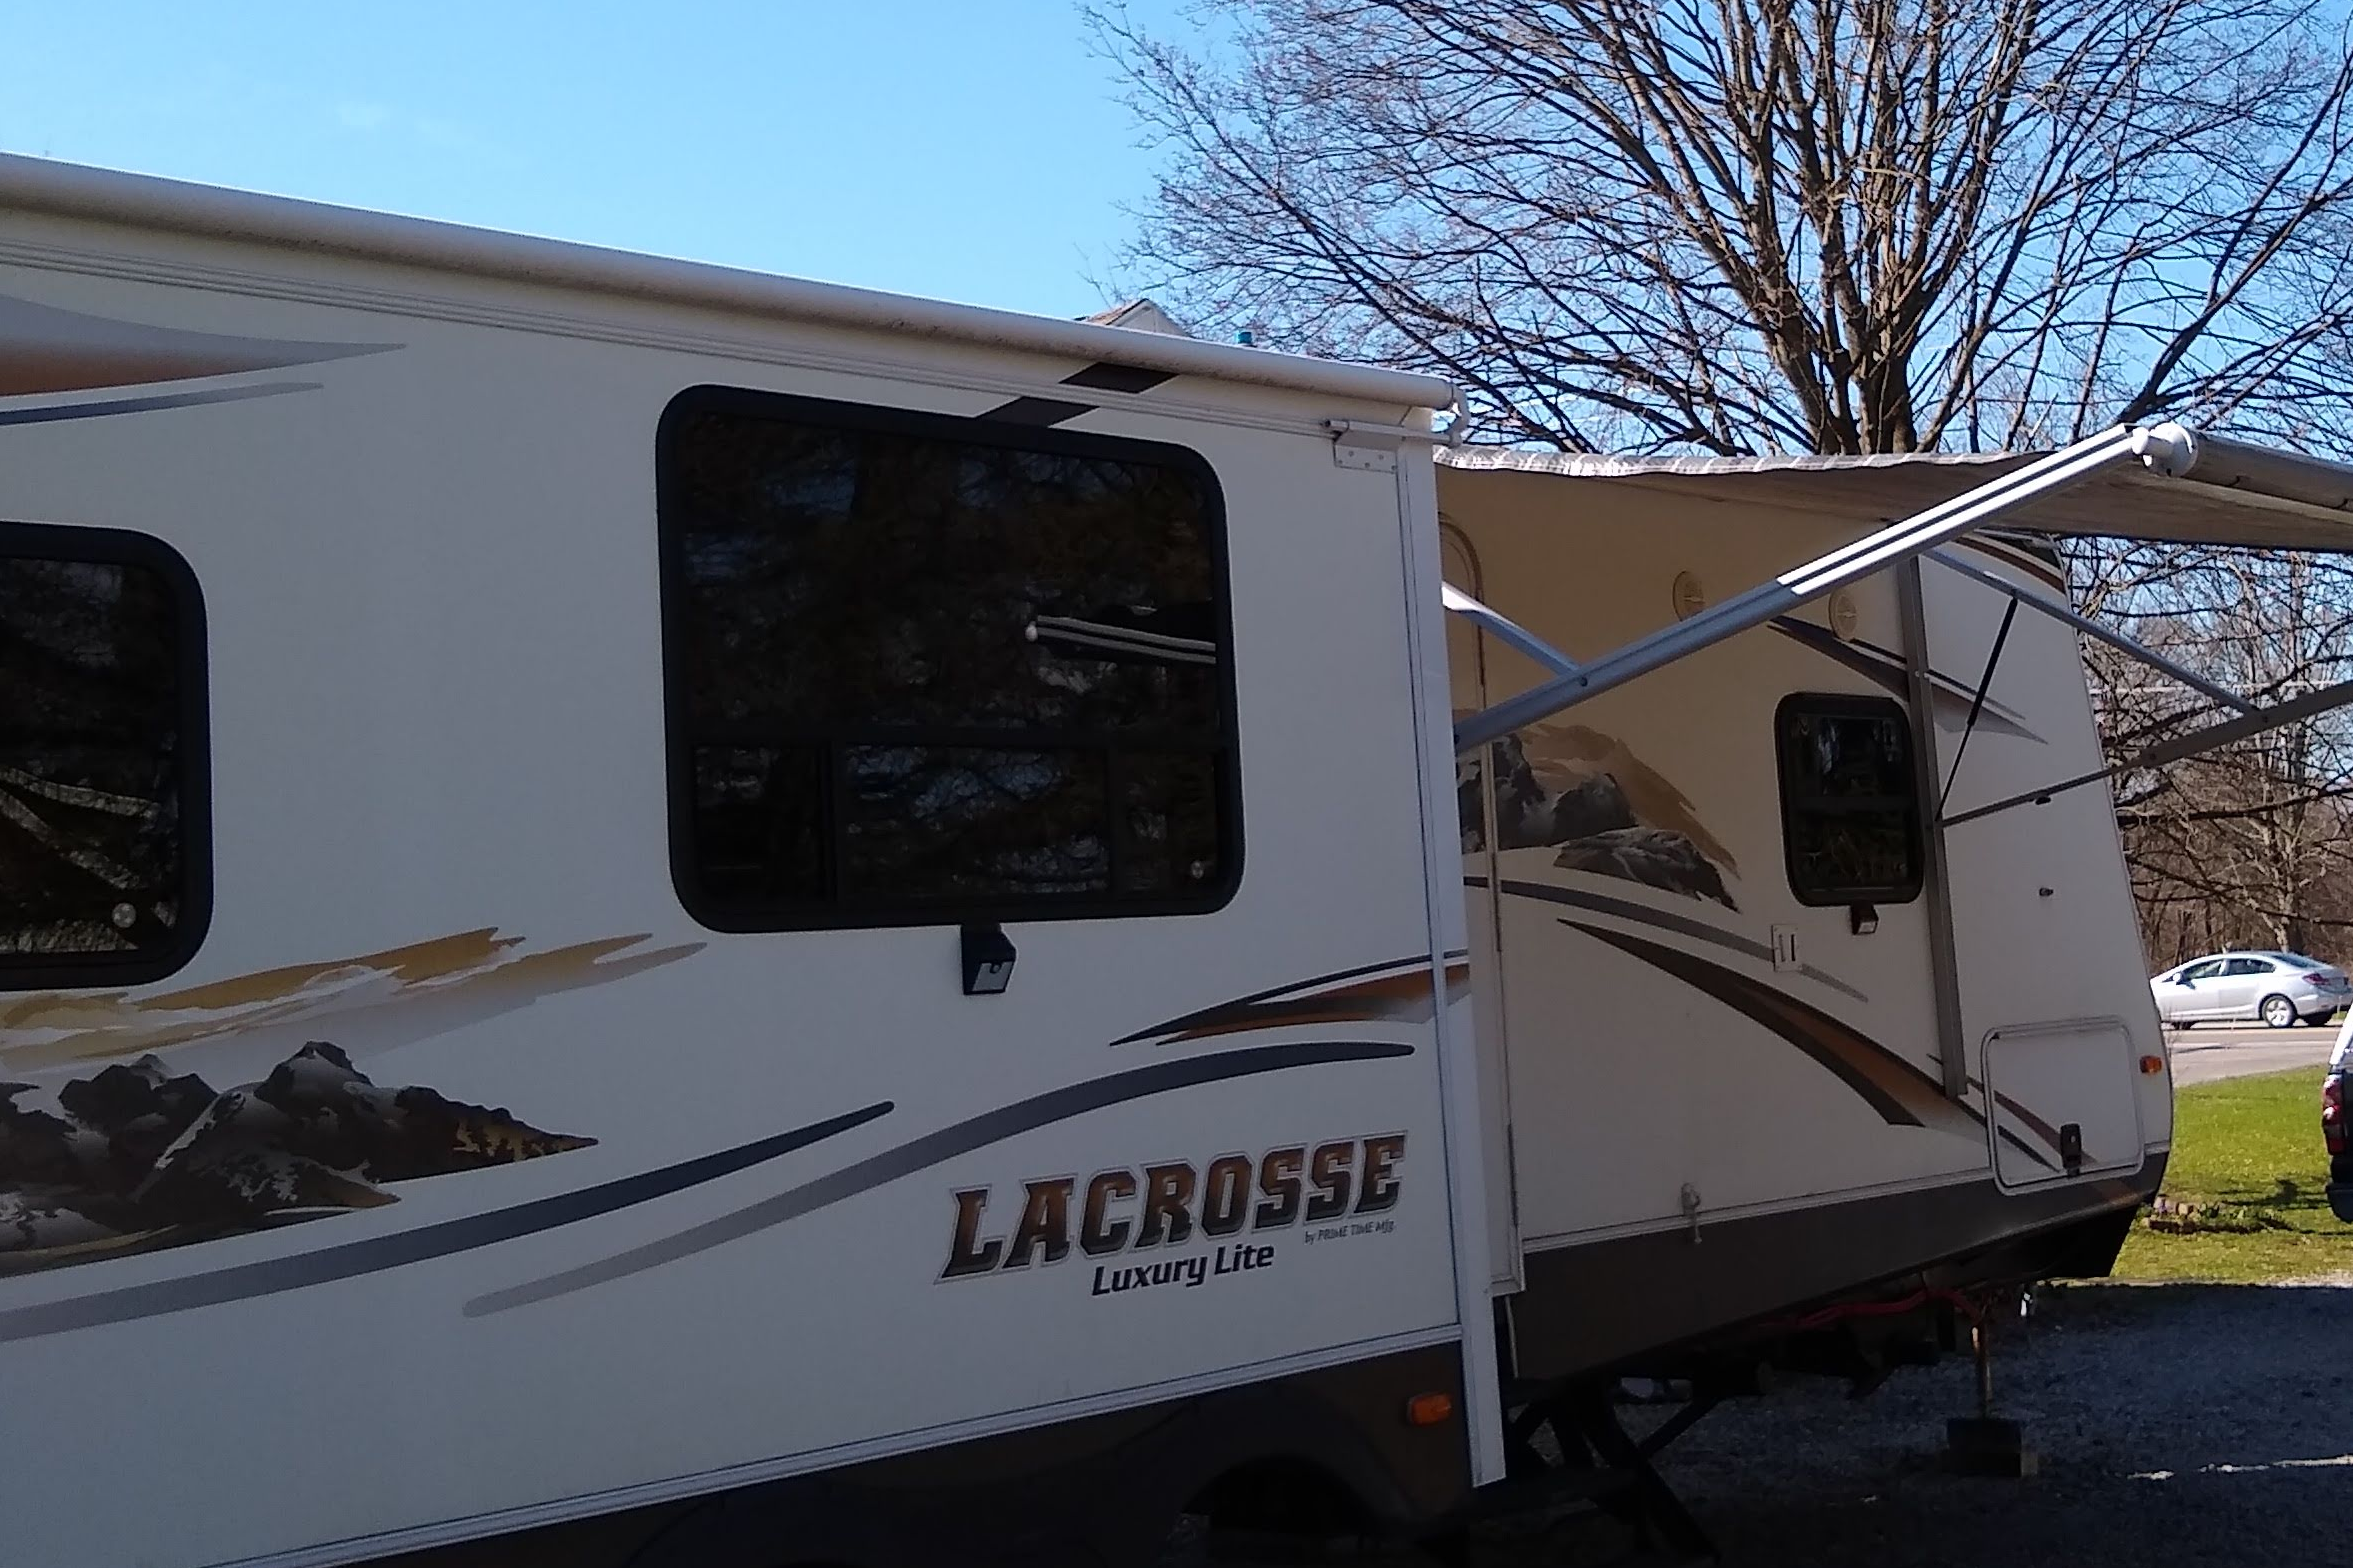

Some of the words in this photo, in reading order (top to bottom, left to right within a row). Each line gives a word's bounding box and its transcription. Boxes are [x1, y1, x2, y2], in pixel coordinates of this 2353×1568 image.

[935, 1130, 1407, 1284] LACROSSE
[1304, 1231, 1316, 1245] by
[1091, 1256, 1208, 1296] Luxury
[1213, 1242, 1275, 1276] Lite
